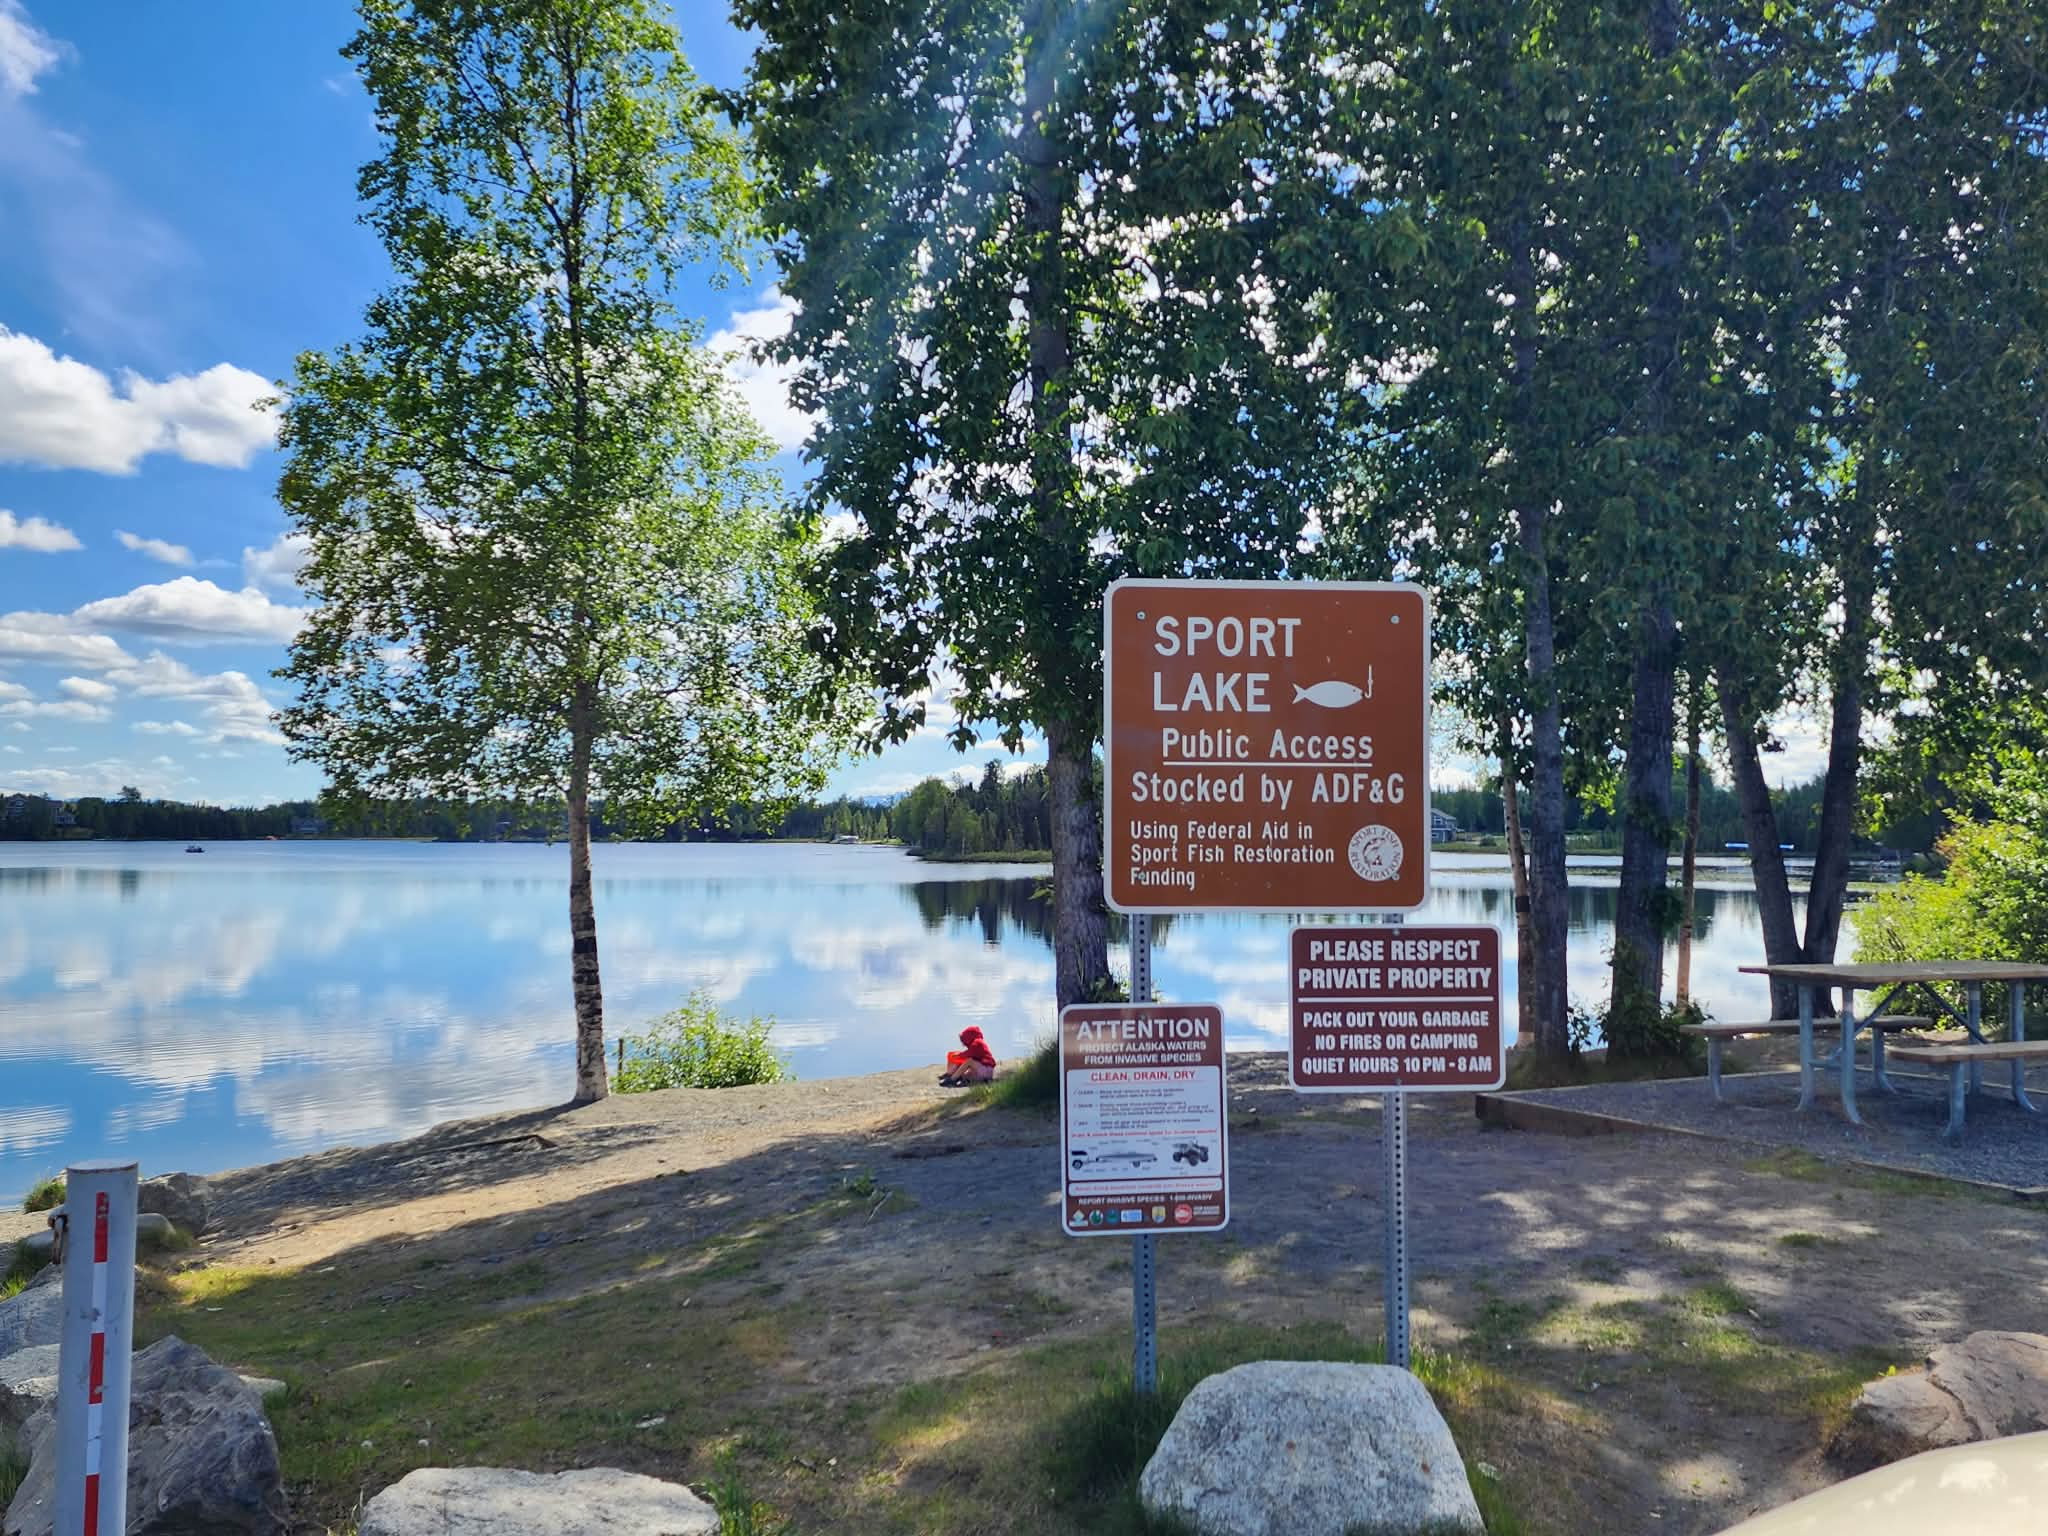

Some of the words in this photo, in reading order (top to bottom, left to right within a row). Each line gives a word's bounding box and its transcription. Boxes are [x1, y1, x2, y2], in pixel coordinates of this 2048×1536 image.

[1154, 615, 1302, 657] SPORT
[1153, 671, 1271, 712] LAKE
[1162, 727, 1250, 758] Public
[1269, 729, 1374, 759] Access
[1131, 771, 1245, 802] Stocked
[1261, 773, 1293, 810] by
[1311, 772, 1405, 803] ADF&G
[1130, 821, 1178, 842] Using
[1187, 821, 1252, 839] Federal
[1262, 821, 1288, 840] Aid
[1298, 821, 1313, 839] in
[1130, 844, 1178, 866] Sport
[1188, 844, 1224, 863] Fish
[1234, 844, 1335, 863] Restoration
[1130, 867, 1196, 891] Funding
[1310, 940, 1385, 961] PLEASE
[1391, 939, 1481, 961] RESPECT
[1298, 967, 1381, 989] PRIVATE
[1387, 967, 1492, 989] PROPERTY
[1076, 1017, 1210, 1041] ATTENTION
[1303, 1012, 1342, 1028] PACK
[1346, 1011, 1375, 1027] OUT
[1379, 1011, 1418, 1027] YOUR
[1422, 1010, 1489, 1027] GARBAGE
[1079, 1042, 1125, 1054] PROTECT
[1125, 1041, 1164, 1052] ALASKA
[1163, 1040, 1207, 1051] WATERS
[1315, 1034, 1336, 1050] NO
[1340, 1034, 1382, 1050] FIRES
[1386, 1034, 1406, 1050] OR
[1410, 1033, 1478, 1049] CAMPING
[1084, 1054, 1113, 1065] FROM
[1115, 1053, 1158, 1064] INVASIVE
[1160, 1052, 1202, 1062] SPECIES
[1302, 1057, 1345, 1075] QUIET
[1349, 1057, 1399, 1073] HOURS
[1091, 1071, 1130, 1082] CLEAN,
[1134, 1071, 1171, 1081] DRAIN,
[1174, 1070, 1196, 1080] DRY
